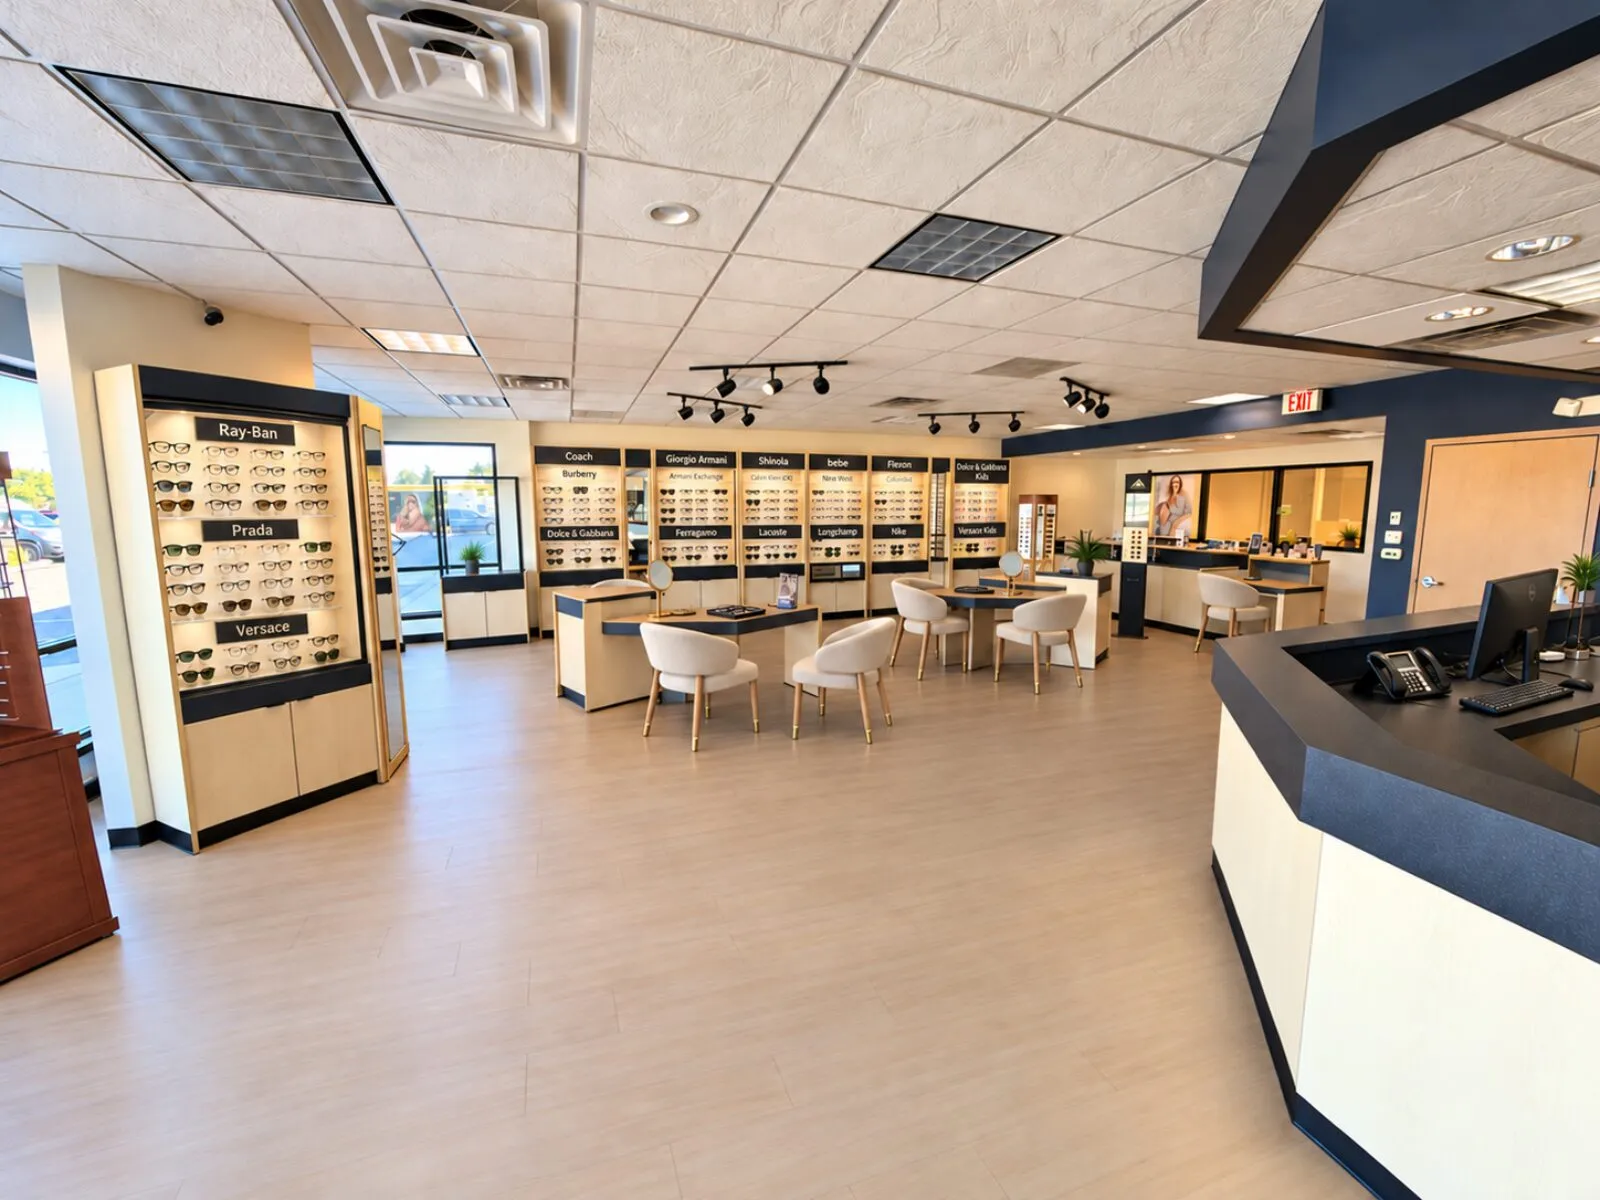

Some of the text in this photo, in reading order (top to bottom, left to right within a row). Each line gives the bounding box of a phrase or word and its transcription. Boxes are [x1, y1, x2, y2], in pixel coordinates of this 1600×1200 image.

[1288, 391, 1313, 412] EXIT
[219, 422, 278, 440] Ray-Ban
[565, 451, 593, 461] Coach
[665, 453, 728, 465] Giorgio Armani
[758, 456, 789, 465] Shinola
[827, 458, 849, 467] bebe
[562, 469, 597, 480] Burberry
[694, 473, 723, 481] Exchange
[975, 472, 989, 480] Kids
[232, 524, 273, 537] Prada
[547, 528, 614, 538] Dolce & Gabbana
[675, 529, 717, 538] Ferragamo
[758, 528, 787, 536] Lacoste
[818, 528, 858, 537] Longchamp
[891, 527, 906, 535] Nike
[983, 526, 997, 534] Kids
[235, 621, 290, 637] Versace
